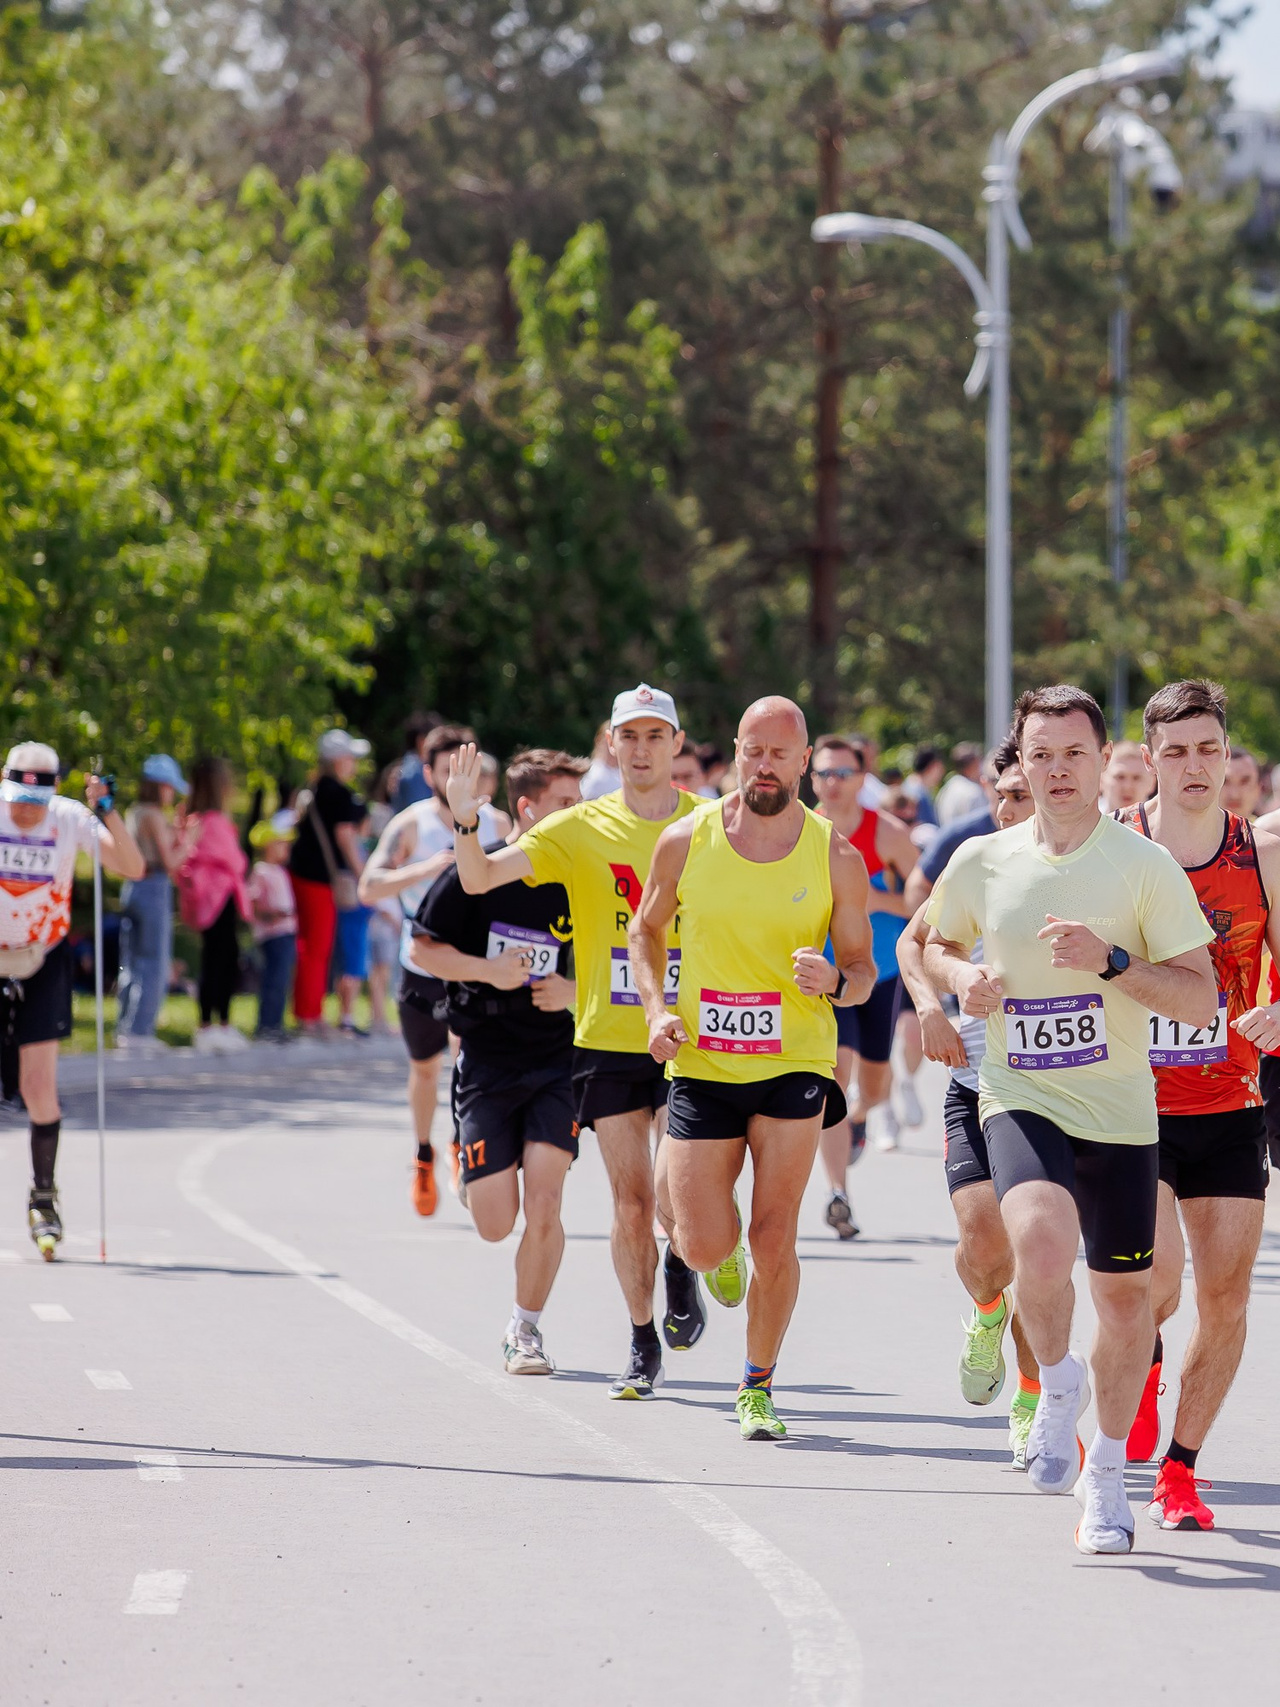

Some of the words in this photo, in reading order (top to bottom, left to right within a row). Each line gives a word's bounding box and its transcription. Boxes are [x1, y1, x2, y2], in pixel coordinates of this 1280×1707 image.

[3, 846, 50, 868] 1479
[706, 1008, 773, 1036] 3403
[1015, 1014, 1096, 1049] 1658
[465, 1139, 486, 1169] 17
